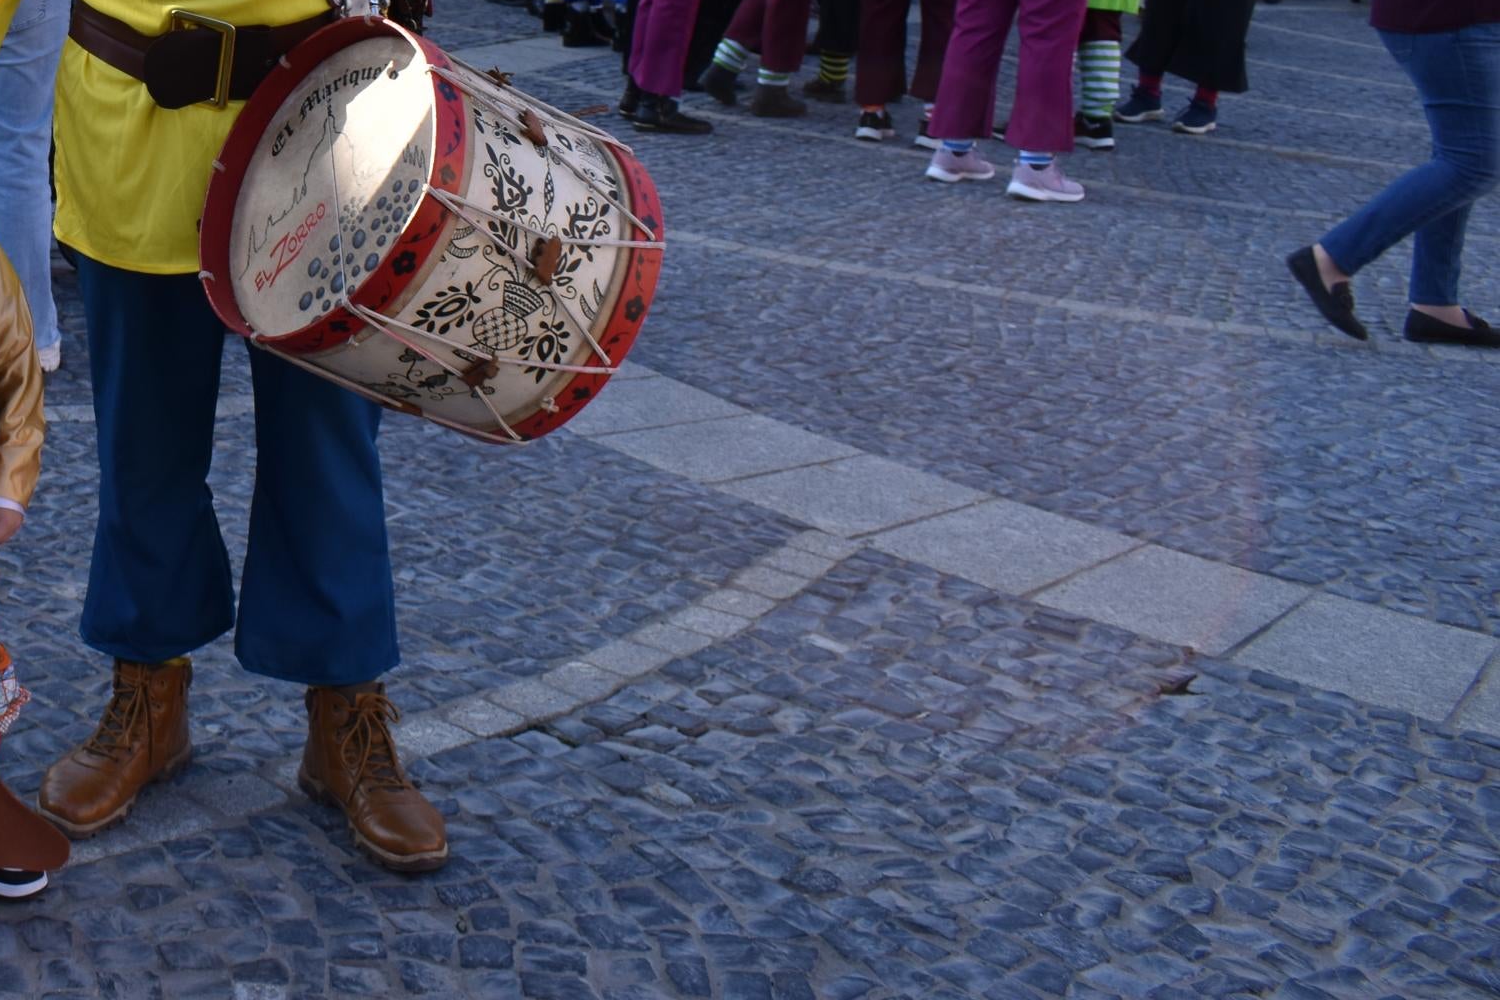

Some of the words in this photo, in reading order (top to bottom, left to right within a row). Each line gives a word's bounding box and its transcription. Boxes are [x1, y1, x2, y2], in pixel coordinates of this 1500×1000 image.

[271, 120, 294, 157] El
[299, 63, 399, 122] Mariqueo
[254, 269, 274, 293] EL
[268, 202, 326, 289] ZORRO
